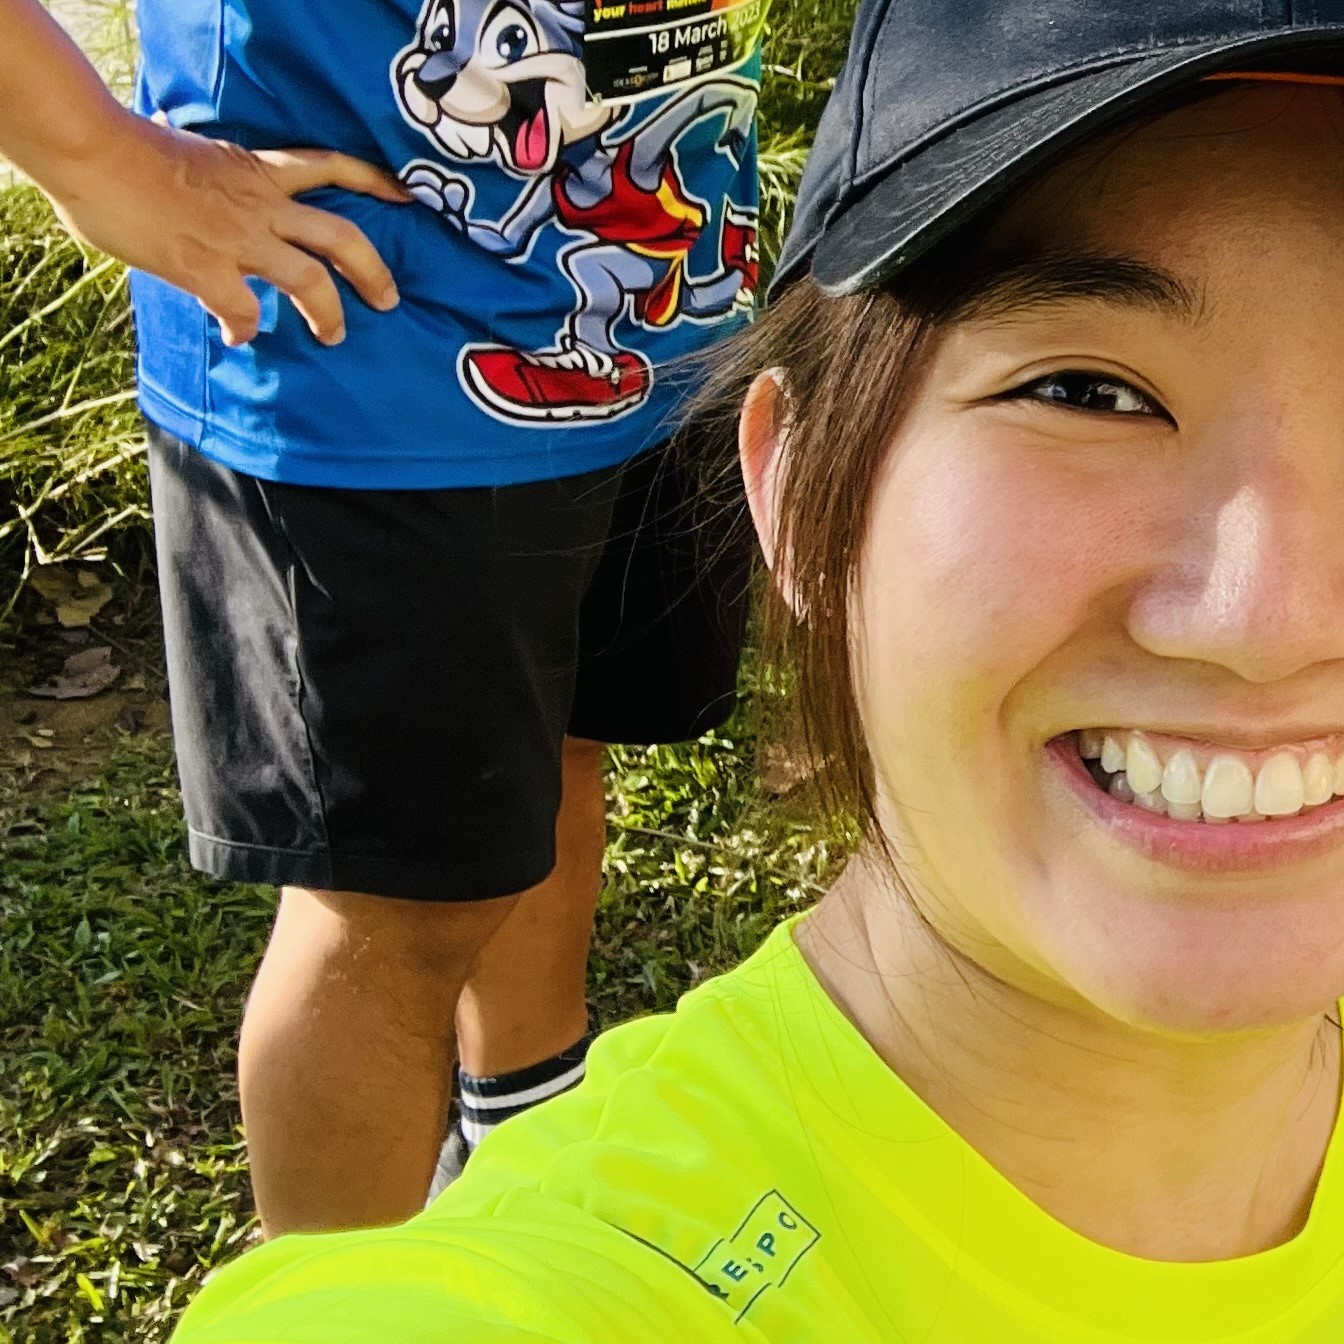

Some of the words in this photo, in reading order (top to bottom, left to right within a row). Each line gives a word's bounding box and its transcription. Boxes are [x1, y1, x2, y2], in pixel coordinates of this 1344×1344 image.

[594, 4, 626, 23] your
[628, 0, 663, 16] heart
[648, 31, 669, 56] 18
[674, 16, 728, 48] March
